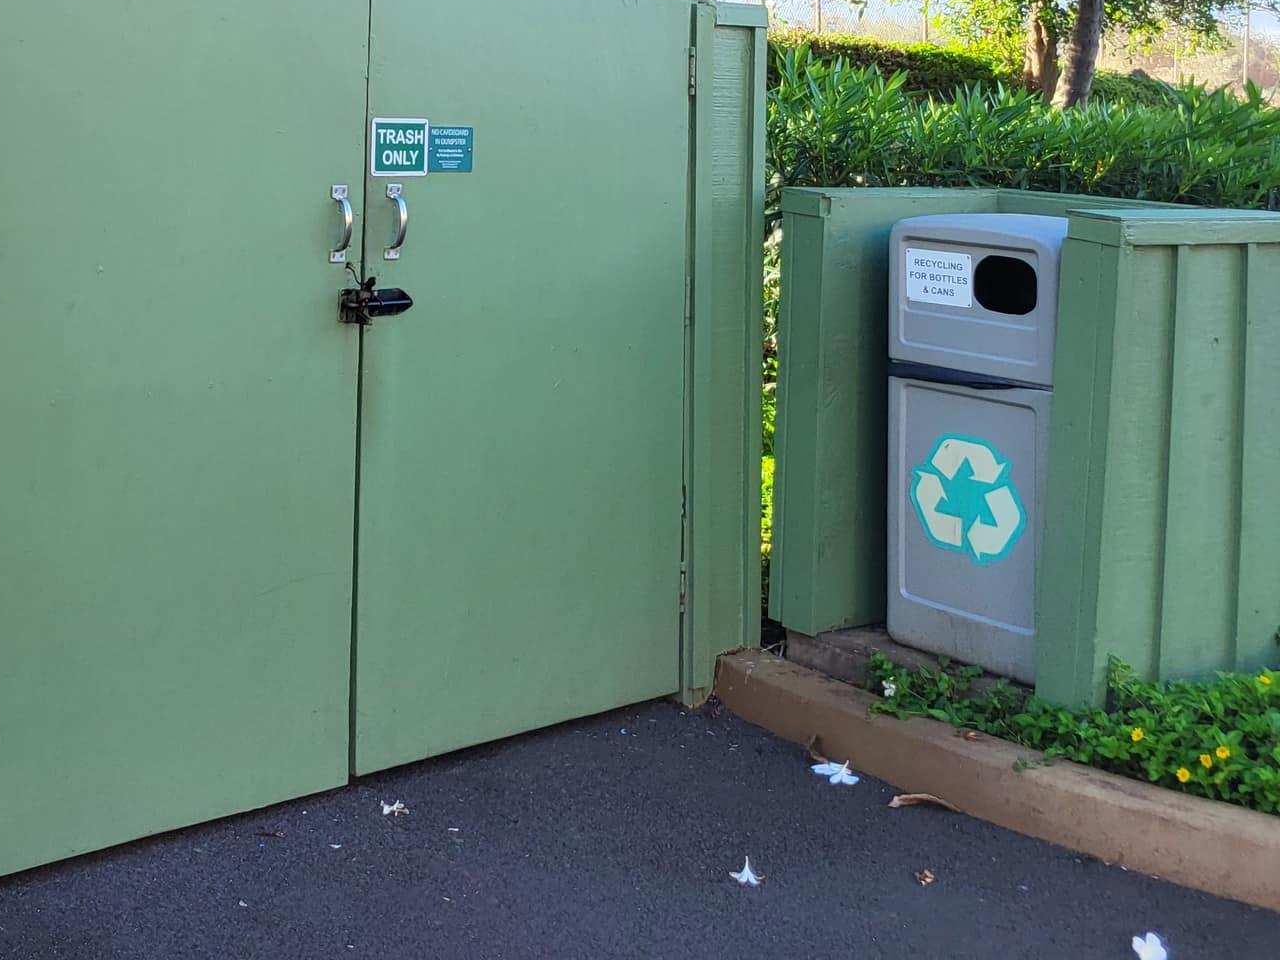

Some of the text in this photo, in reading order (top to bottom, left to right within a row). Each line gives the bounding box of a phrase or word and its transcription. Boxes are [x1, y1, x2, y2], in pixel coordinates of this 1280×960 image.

[377, 129, 424, 144] TRASH
[431, 128, 439, 136] NO
[382, 150, 419, 165] ONLY
[914, 258, 963, 271] RECYCLING
[909, 271, 968, 285] FOR BOTTLES
[923, 286, 955, 296] & CANS
